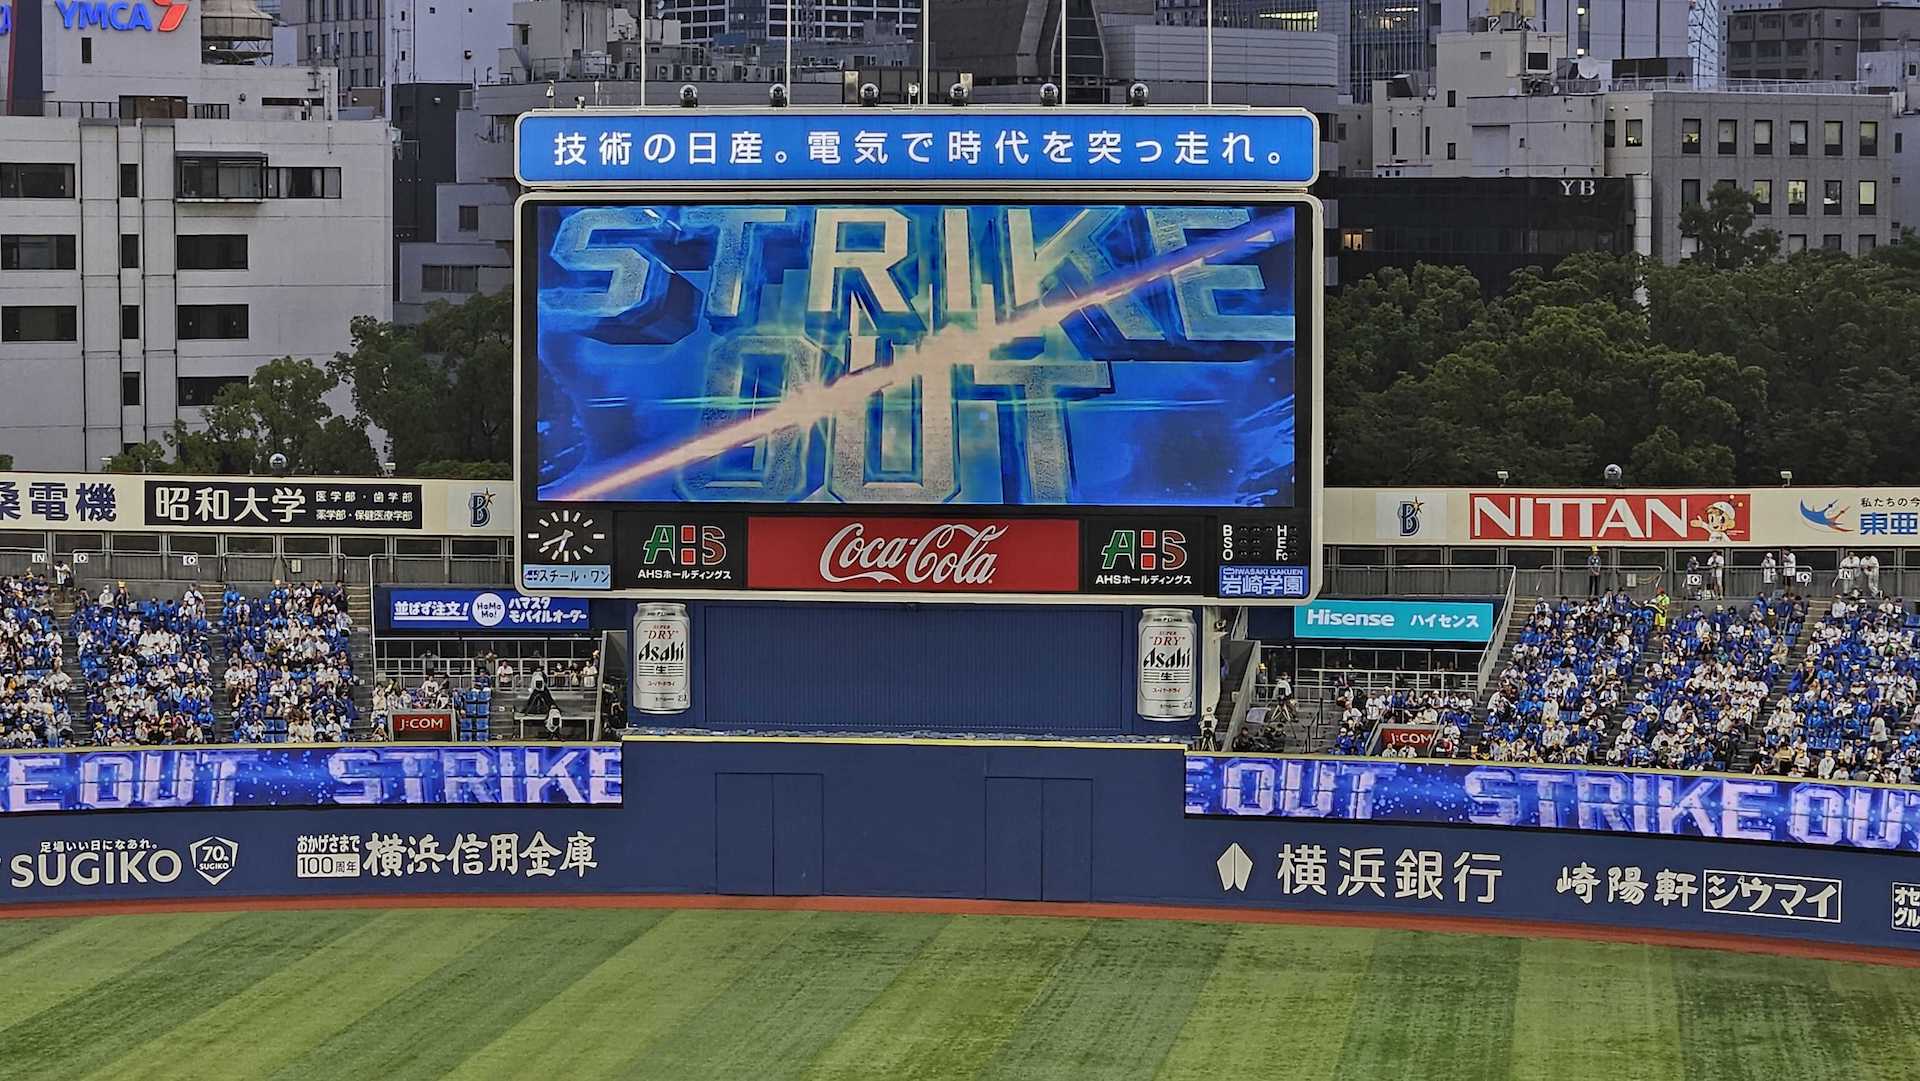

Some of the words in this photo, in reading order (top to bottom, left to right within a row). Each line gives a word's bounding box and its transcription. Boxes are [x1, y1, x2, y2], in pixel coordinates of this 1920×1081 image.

[56, 0, 152, 31] YMCA
[554, 131, 1281, 166] 技術の日産。電気で時代を突っ走れ。
[540, 207, 1294, 341] STRIKE
[695, 334, 1112, 503] OUT
[155, 486, 307, 523] 昭和大学
[1474, 496, 1688, 538] NITTAN
[1222, 524, 1233, 537] B
[1277, 525, 1288, 537] H
[1222, 536, 1233, 549] S
[1277, 538, 1287, 549] E
[819, 523, 1008, 584] Coca-Cola
[539, 569, 610, 583] スチール・ワン
[638, 570, 732, 580] AHSホールディングス
[1095, 574, 1192, 585] AHSホールディングス
[1235, 568, 1268, 576] IWASAKI
[1270, 568, 1304, 576] GAKUEN
[1222, 575, 1303, 595] 岩崎学園
[508, 596, 551, 609] ハマスタ
[509, 609, 587, 624] モバイルオーダー
[1307, 608, 1395, 627] Hisense
[1410, 613, 1480, 628] ハイセンス
[648, 630, 676, 640] DRY
[1153, 636, 1182, 646] DRY
[638, 640, 685, 662] Asahi
[1143, 647, 1191, 669] Asahi
[399, 718, 444, 731] J:COM
[1390, 732, 1433, 745] J:COM
[79, 750, 258, 809] OUT
[328, 747, 622, 805] STRIKE
[1223, 757, 1398, 819] OUT
[1464, 768, 1777, 841] STRIKE
[1788, 783, 1920, 849] OU
[40, 839, 157, 853] 足場いい日になあれ。
[297, 834, 360, 853] おかげさまで
[363, 831, 598, 878] 横浜信用金庫
[10, 849, 182, 888] SUGIKO
[199, 862, 229, 871] SUGIKO
[299, 856, 357, 875] 100周年
[1277, 844, 1502, 903] 横浜銀行
[1556, 861, 1698, 907] 崎陽軒
